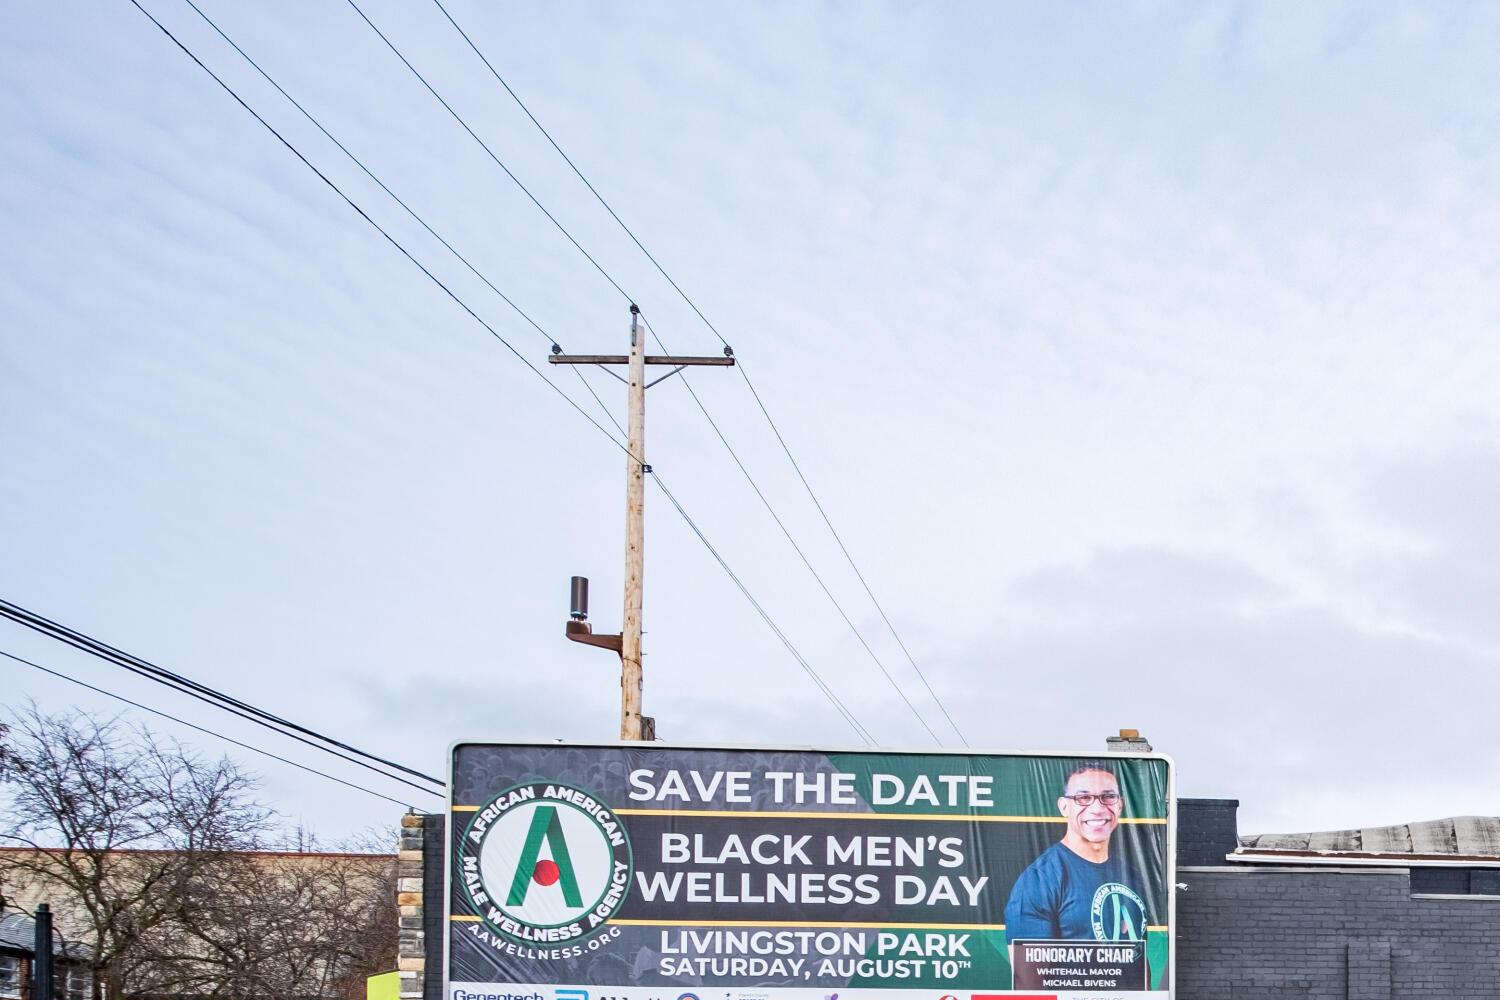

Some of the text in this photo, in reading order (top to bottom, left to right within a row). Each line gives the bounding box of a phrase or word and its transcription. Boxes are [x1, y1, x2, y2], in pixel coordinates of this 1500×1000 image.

[629, 769, 994, 807] SAVE THE DATE
[468, 785, 625, 847] AFRICAN AMERICAN
[661, 833, 964, 868] BLACK MEN’S
[463, 856, 628, 942] MALE WELLNESS AGENCY
[635, 871, 989, 907] WELLNESS DAY
[468, 924, 621, 960] AAWELLNESS.ORG
[661, 930, 971, 958] LIVINGSTON PARK
[1025, 948, 1134, 963] HONORARY CHAIR
[659, 957, 971, 980] SATURDAY, AUGUST 10TH
[1036, 968, 1122, 976] WHITEHALL MAYOR
[1042, 979, 1116, 987] MICHAEL BIVENS
